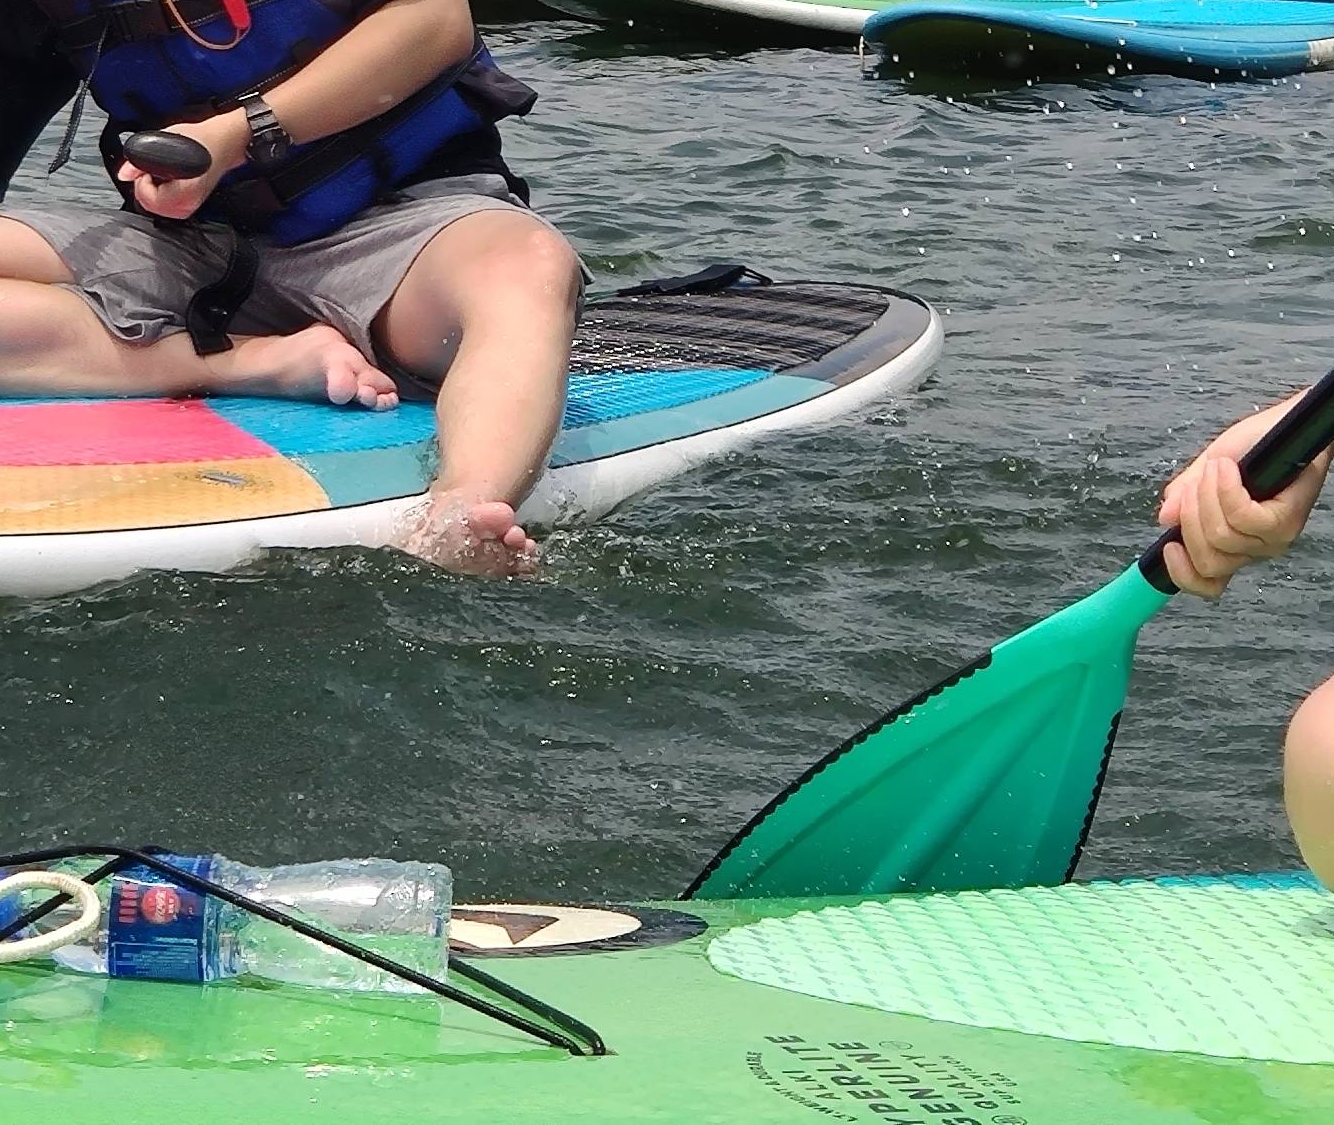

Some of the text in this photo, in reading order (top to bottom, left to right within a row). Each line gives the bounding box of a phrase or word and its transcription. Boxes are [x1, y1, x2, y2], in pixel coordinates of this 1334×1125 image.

[764, 1035, 925, 1125] YPERLITE
[781, 1070, 842, 1100] ALKI
[900, 1054, 999, 1110] QUALITY
[989, 1072, 1017, 1087] USA
